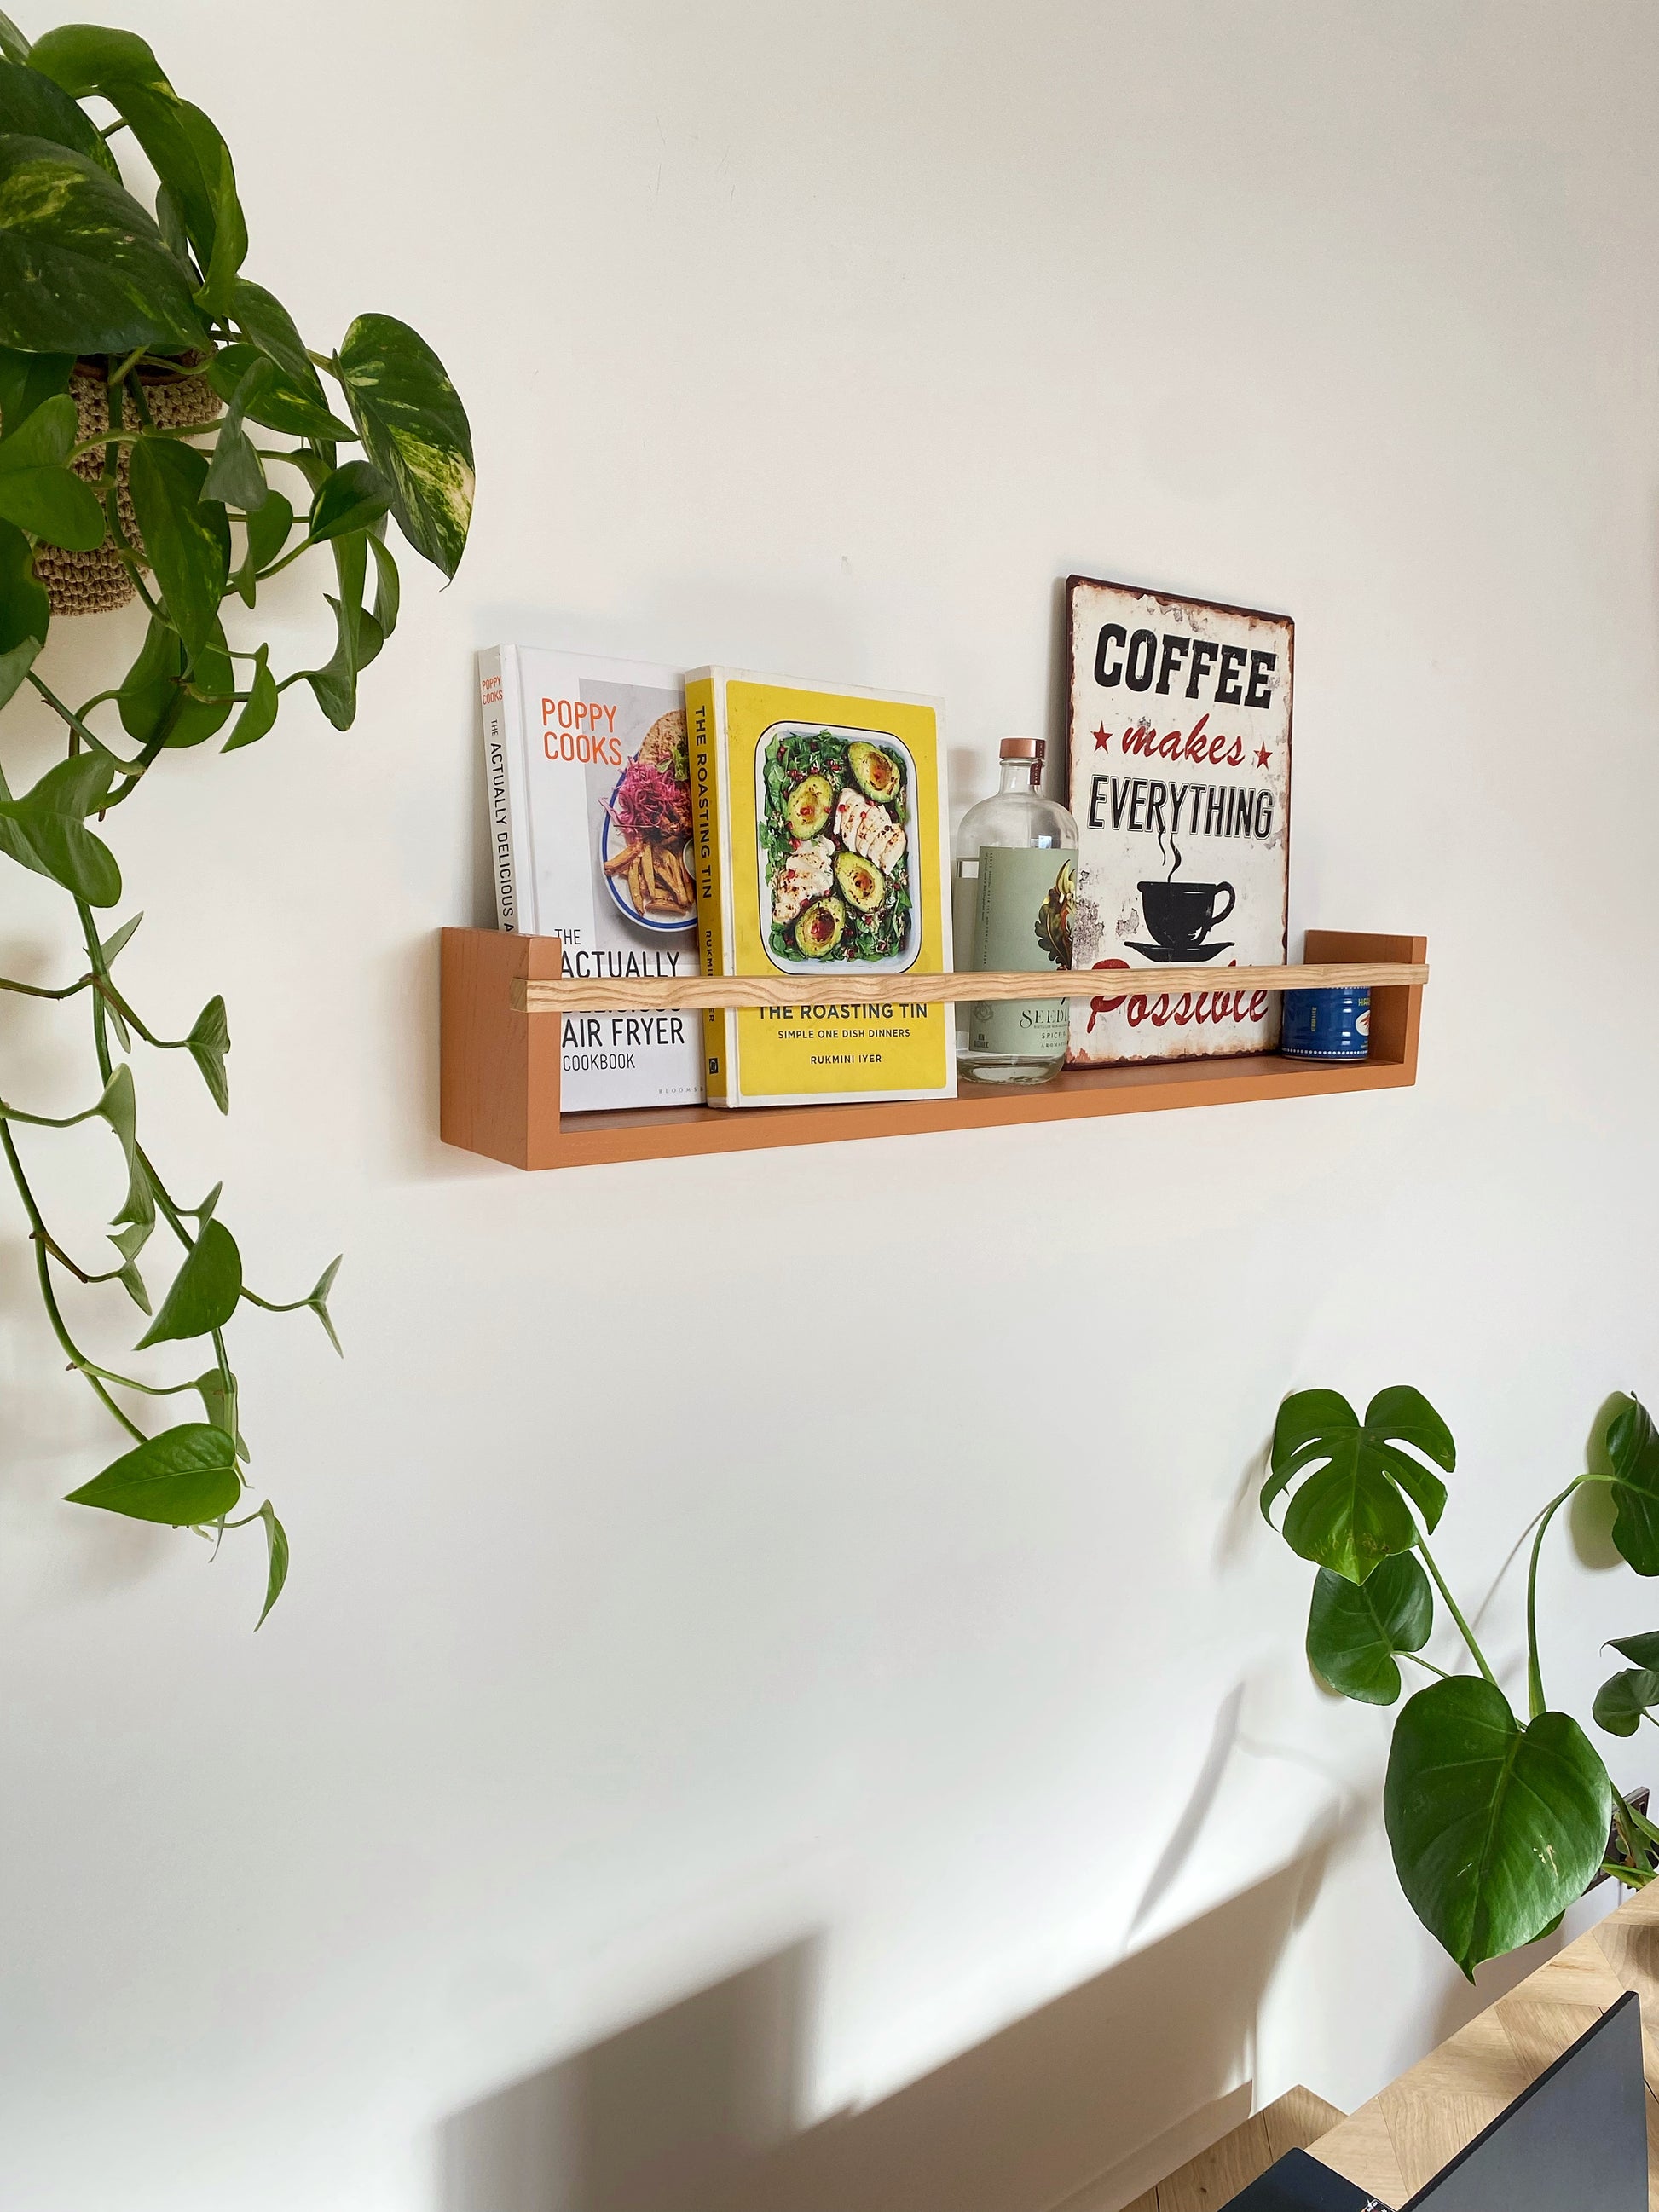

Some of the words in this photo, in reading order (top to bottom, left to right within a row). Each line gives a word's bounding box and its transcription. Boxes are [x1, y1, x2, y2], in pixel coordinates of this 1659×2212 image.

[483, 675, 501, 690] POPPY
[1094, 623, 1277, 709] COFFEE
[483, 690, 503, 705] COOKS
[541, 697, 618, 733] POPPY
[695, 705, 707, 746] THE
[544, 731, 623, 766] COOKS
[1121, 713, 1246, 767] makes
[490, 743, 508, 825] ACTUALLY
[697, 753, 711, 858] ROASTING
[1086, 773, 1275, 840] EVERYTHING
[497, 832, 514, 917] DELICIOUS
[702, 865, 712, 898] TIN
[554, 928, 581, 945] THE
[562, 950, 680, 978] ACTUALLY
[758, 1005, 794, 1020] THE
[800, 1003, 894, 1019] ROASTING
[900, 1002, 928, 1019] TIN
[561, 1019, 603, 1048] AIR
[612, 1017, 685, 1047] FRYER
[777, 1030, 814, 1039] SIMPLE
[818, 1029, 839, 1039] ONE
[842, 1028, 865, 1038] DISH
[868, 1028, 910, 1038] DINNERS
[563, 1053, 636, 1071] COOKBOOK
[810, 1054, 855, 1066] RUKMINI
[858, 1054, 882, 1064] IYER
